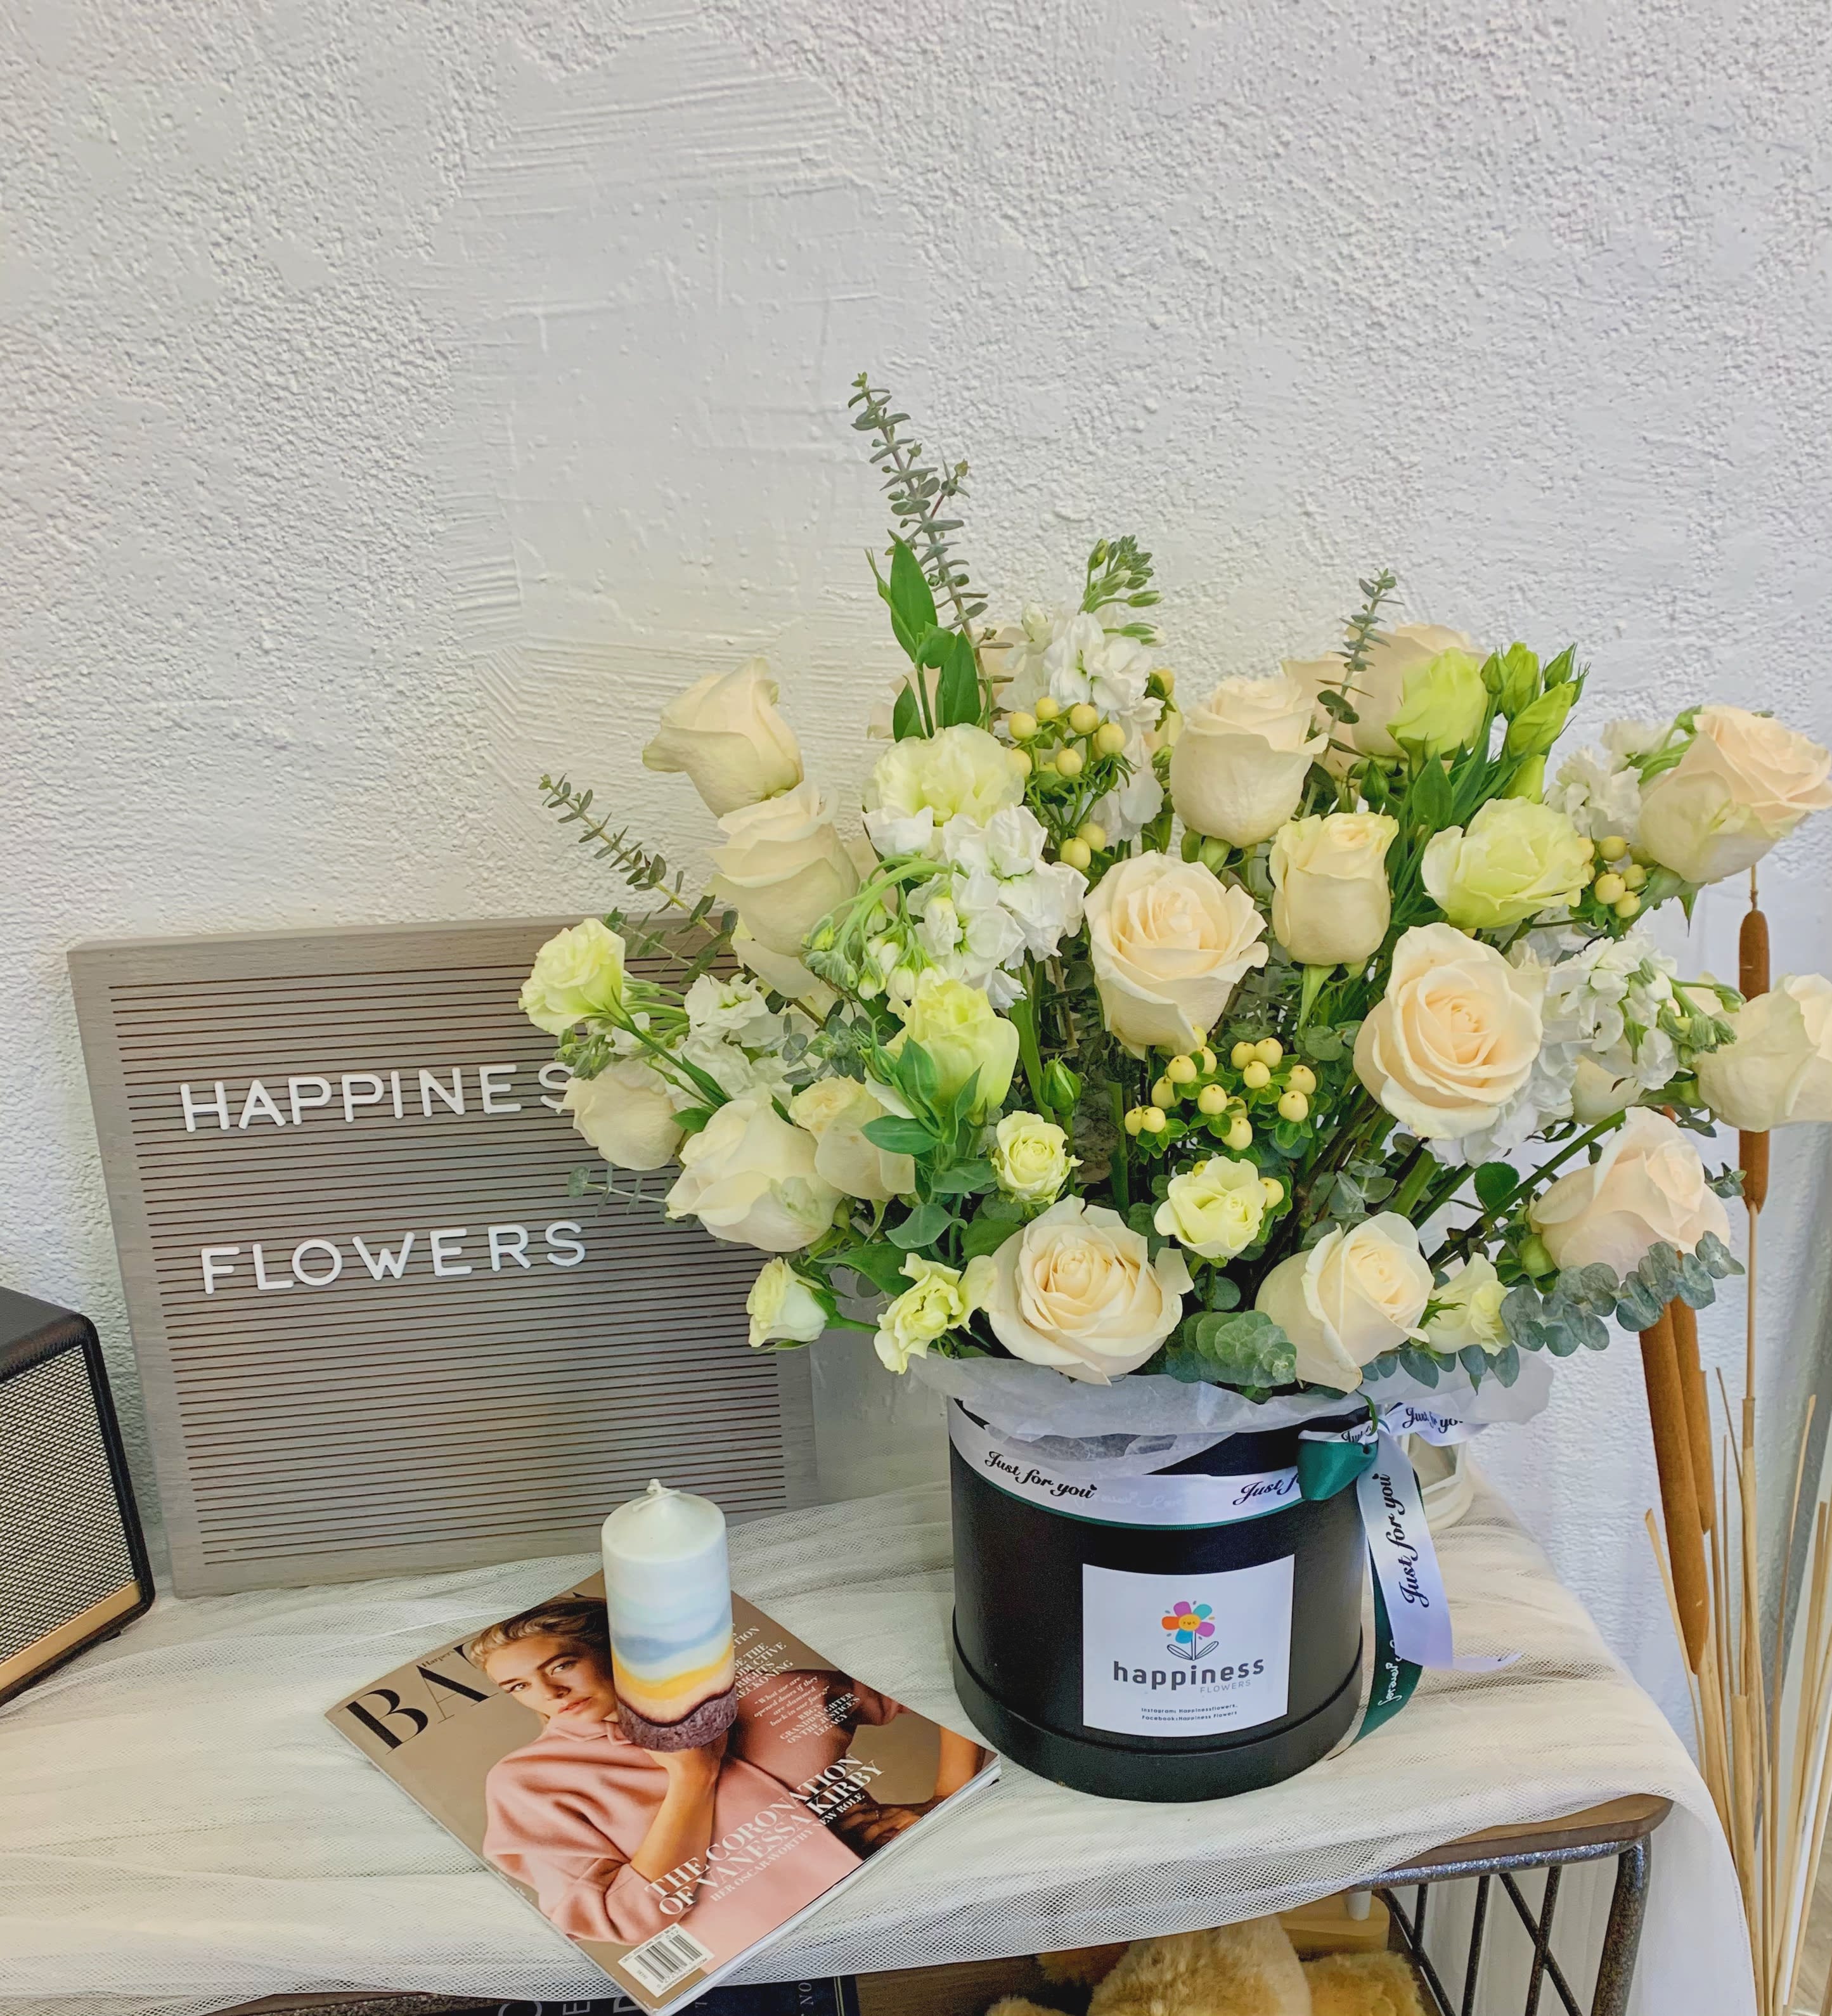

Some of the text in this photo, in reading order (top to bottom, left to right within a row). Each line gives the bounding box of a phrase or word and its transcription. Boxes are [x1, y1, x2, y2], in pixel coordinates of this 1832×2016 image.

[201, 1220, 586, 1295] FLOWERS
[1438, 1418, 1463, 1433] yo
[984, 1451, 1097, 1499] Just for you
[1232, 1479, 1284, 1505] Just
[1378, 1473, 1429, 1608] Just for you
[733, 1625, 760, 1649] TION
[743, 1643, 769, 1660] THE
[735, 1660, 775, 1688] RIGHTS
[1114, 1659, 1264, 1691] happiness
[1200, 1679, 1251, 1694] FLOWERS
[778, 1690, 797, 1703] doors
[797, 1683, 804, 1693] if
[804, 1676, 818, 1687] they
[787, 1732, 802, 1744] ON
[799, 1722, 821, 1736] THE
[813, 1713, 848, 1737] LEGACY
[643, 1753, 864, 1899] THE CORONATION
[658, 1759, 886, 1916] OF VANESSA KIRBY
[709, 1882, 737, 1902] HER
[734, 1828, 815, 1888] OSCAR-WORTHY
[835, 1792, 866, 1814] ROLE
